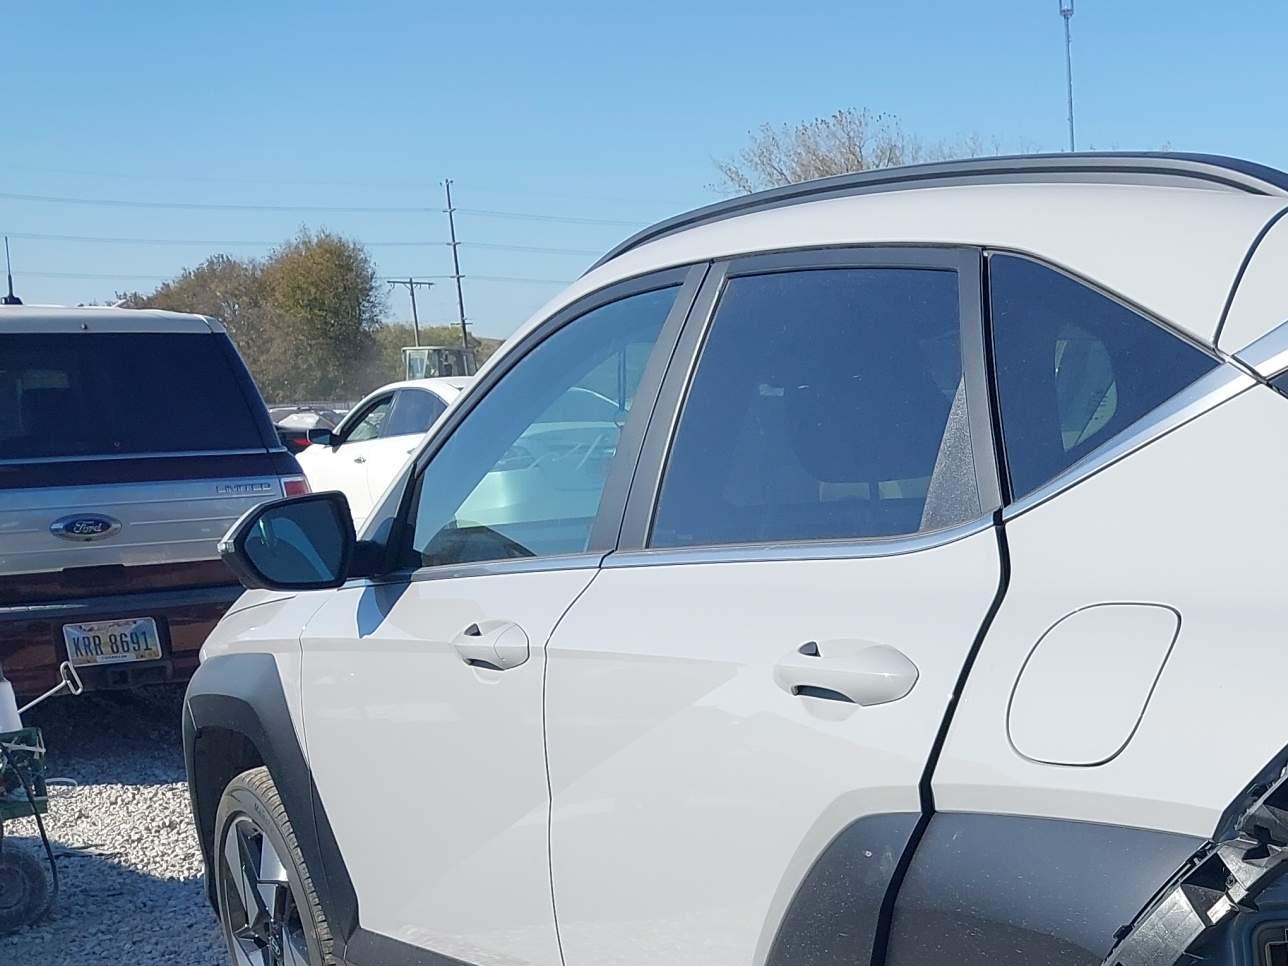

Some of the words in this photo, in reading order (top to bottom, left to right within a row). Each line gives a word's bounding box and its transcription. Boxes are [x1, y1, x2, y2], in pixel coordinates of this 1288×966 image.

[73, 520, 103, 533] Ford
[72, 635, 104, 657] KRR
[108, 631, 153, 654] 8691
